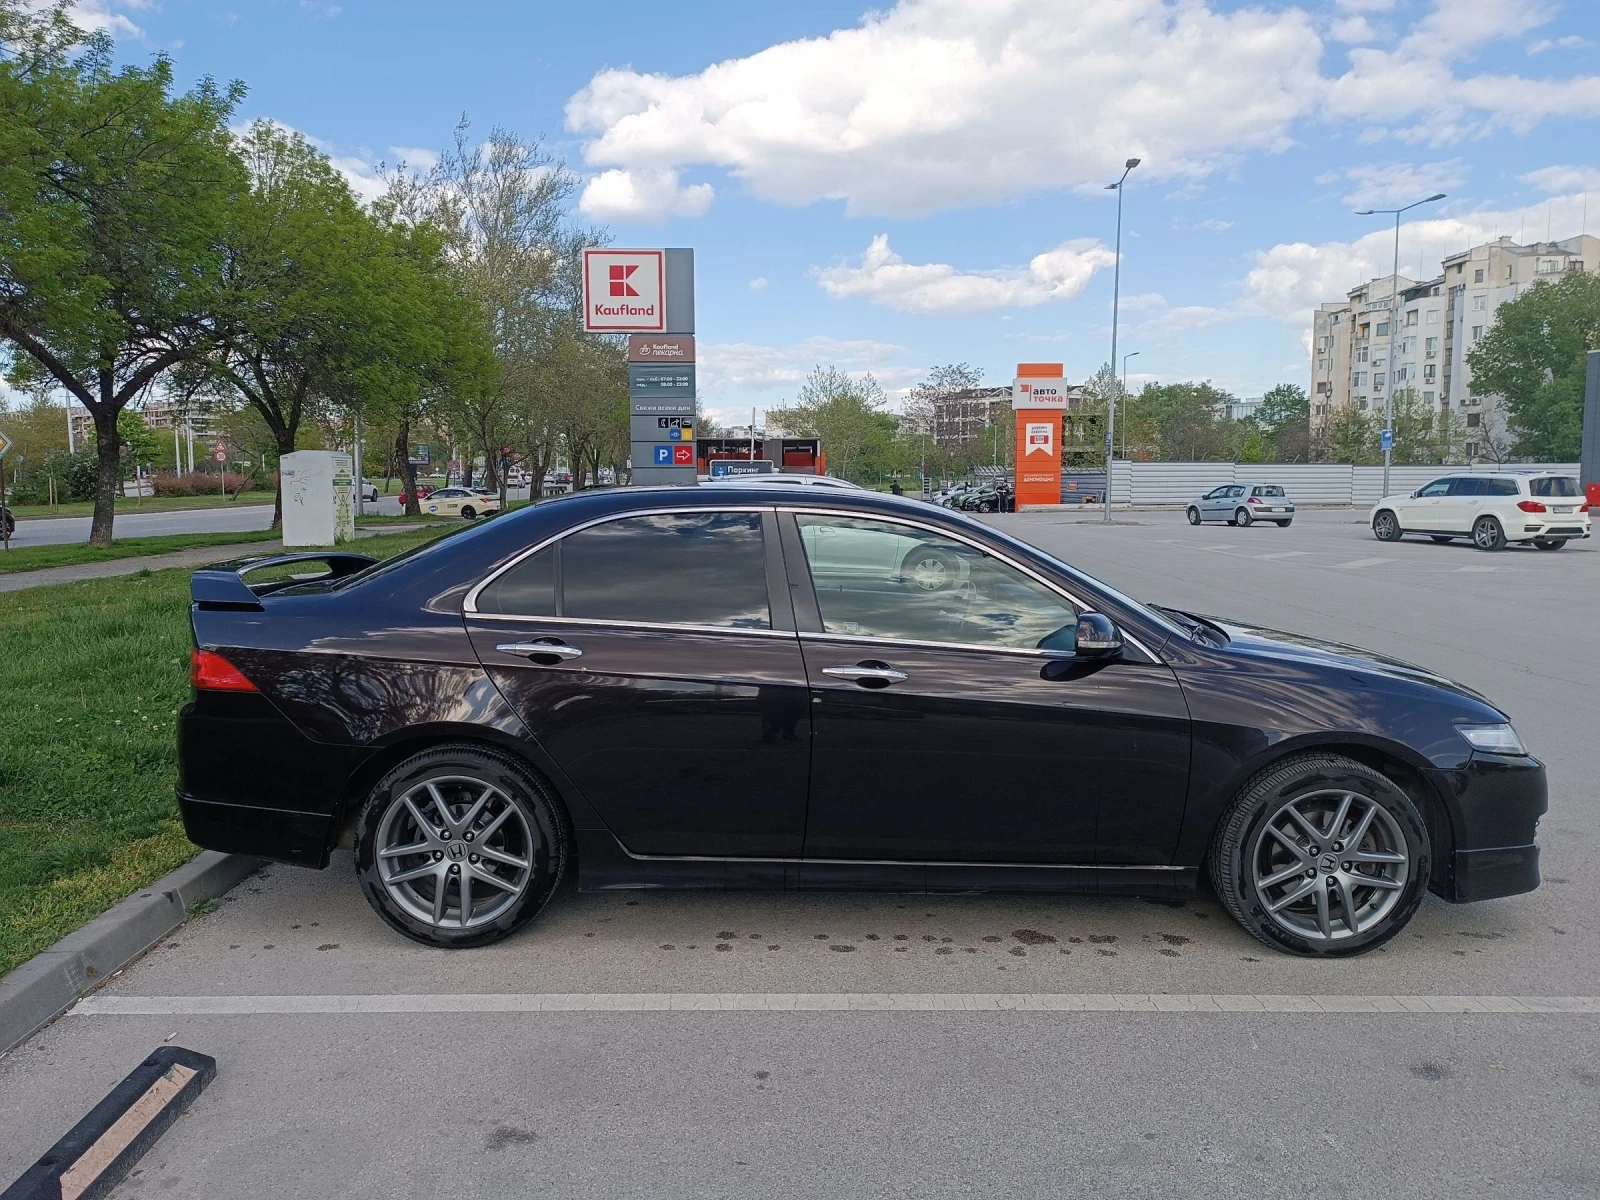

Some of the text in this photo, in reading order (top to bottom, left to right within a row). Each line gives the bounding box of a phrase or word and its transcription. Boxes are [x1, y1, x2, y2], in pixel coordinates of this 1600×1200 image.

[595, 304, 654, 316] Kaufland
[652, 349, 684, 357] пекарна
[1033, 387, 1057, 395] авто
[1033, 395, 1064, 403] точка
[727, 465, 760, 475] Паркинг
